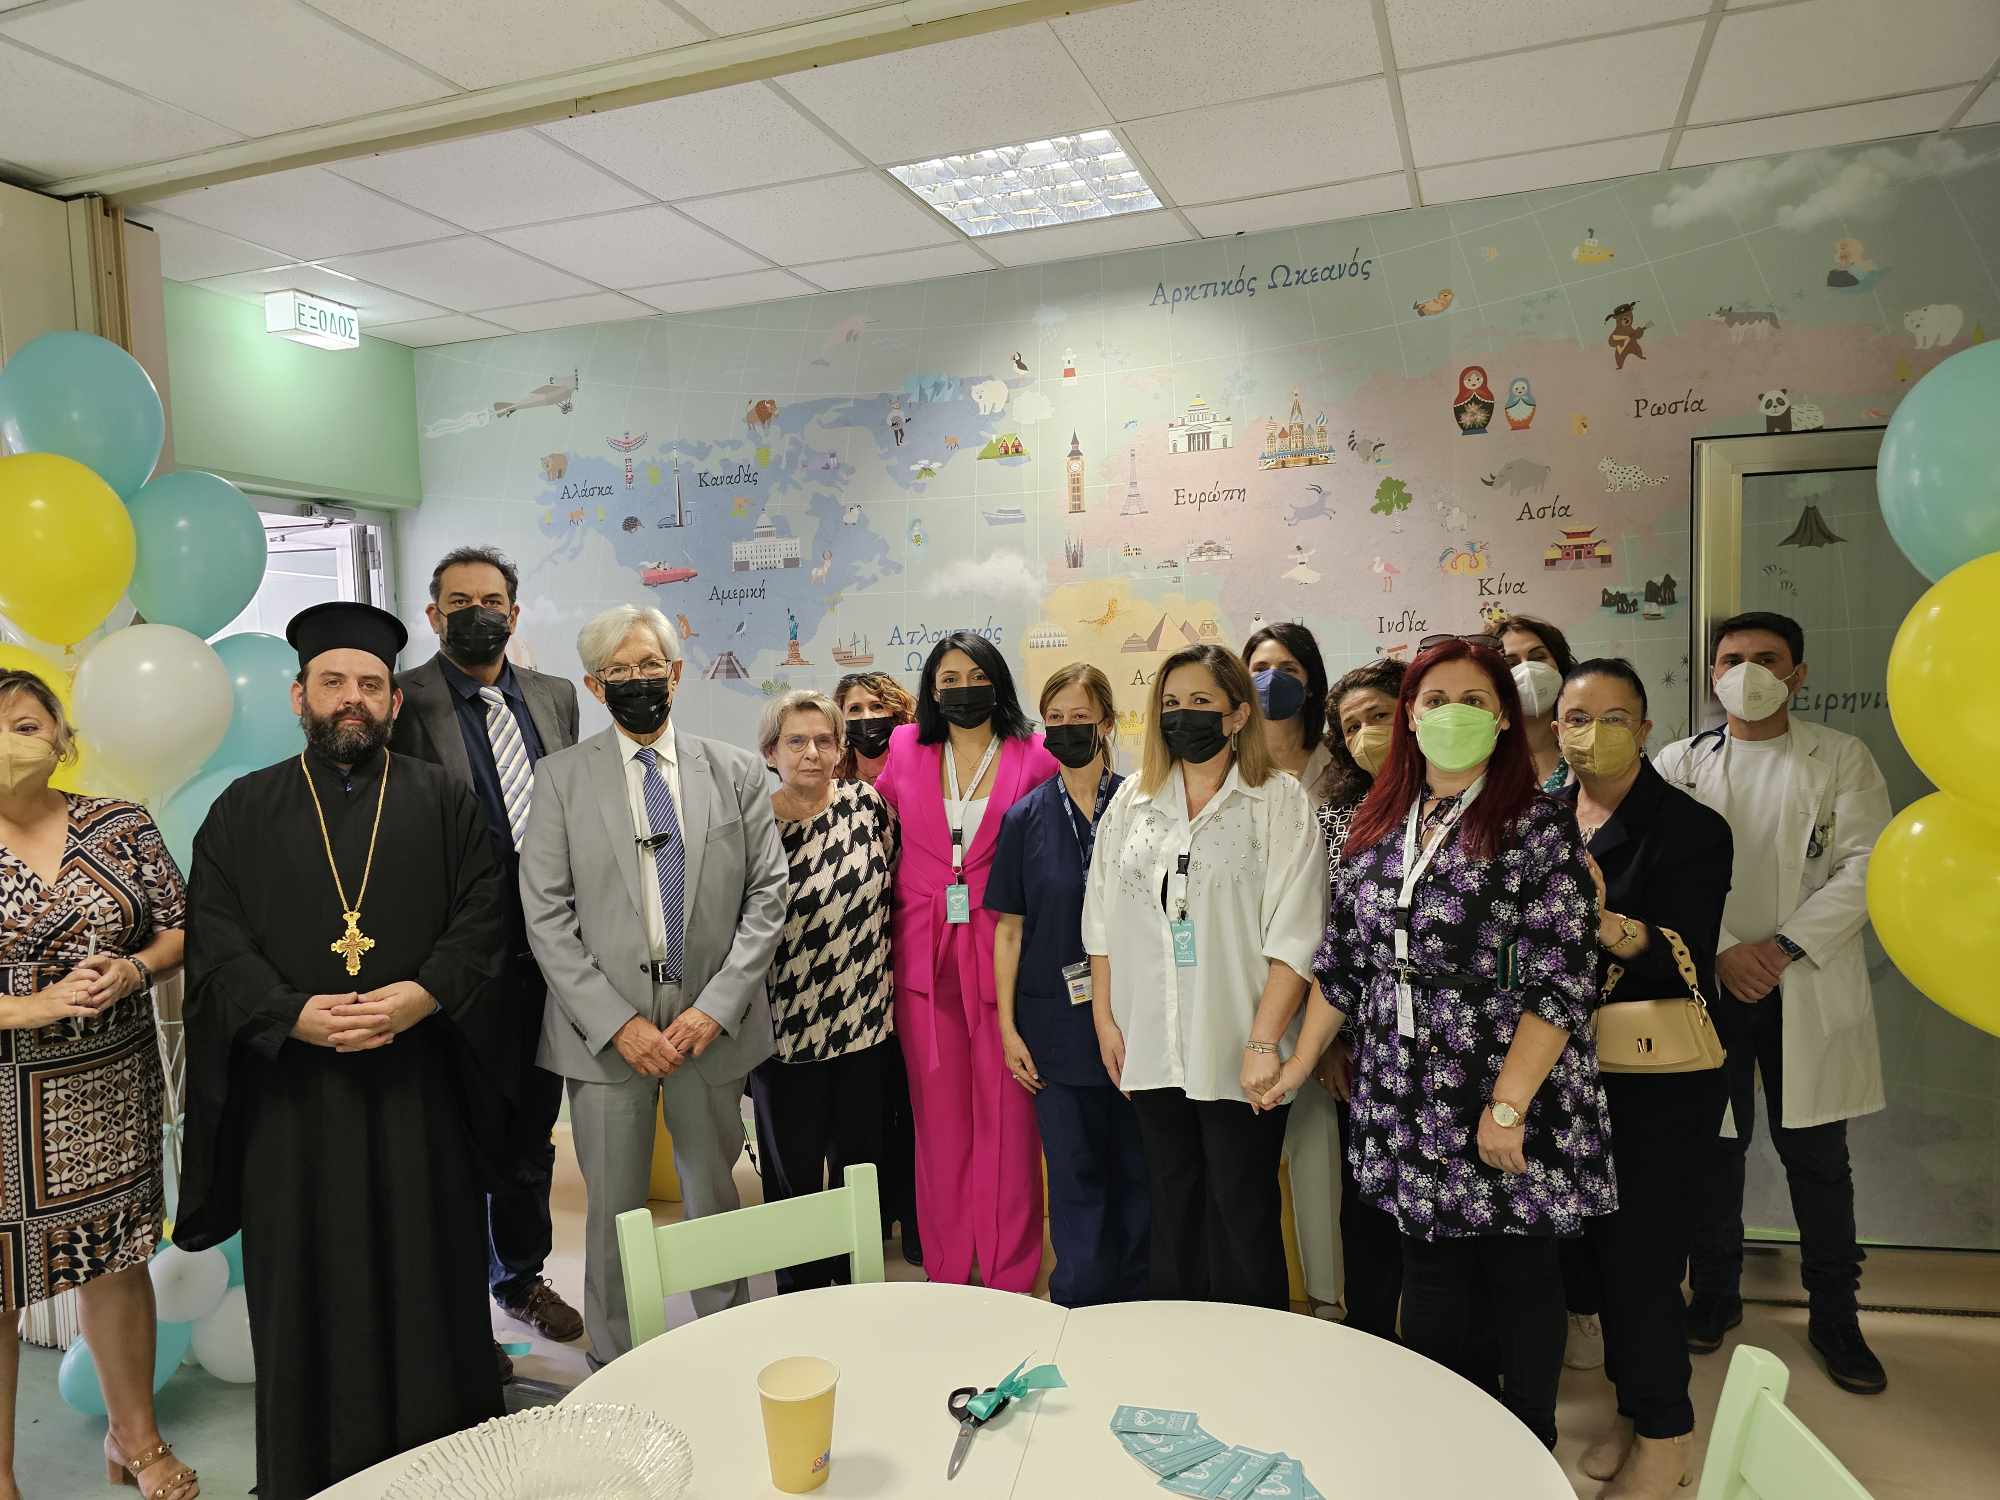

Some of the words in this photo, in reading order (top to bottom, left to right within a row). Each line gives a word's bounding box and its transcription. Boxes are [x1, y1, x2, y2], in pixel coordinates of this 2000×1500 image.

[1149, 264, 1257, 314] Αρκτικός
[1267, 248, 1373, 289] Ωκεανός
[297, 302, 357, 340] ΕΞΟΔΟΣ
[1633, 388, 1709, 418] Ρωσία
[560, 480, 616, 500] Αλάσκα
[697, 464, 760, 488] Καναδάς
[1173, 480, 1246, 512] Ευρώπη
[1516, 495, 1575, 521] Ασία
[708, 579, 767, 605] Αμερική
[1477, 572, 1529, 596] Κίνα
[887, 615, 1003, 645] Ατλανός
[1376, 610, 1430, 634] Ινδία
[1788, 686, 1889, 722] Ειρηνι
